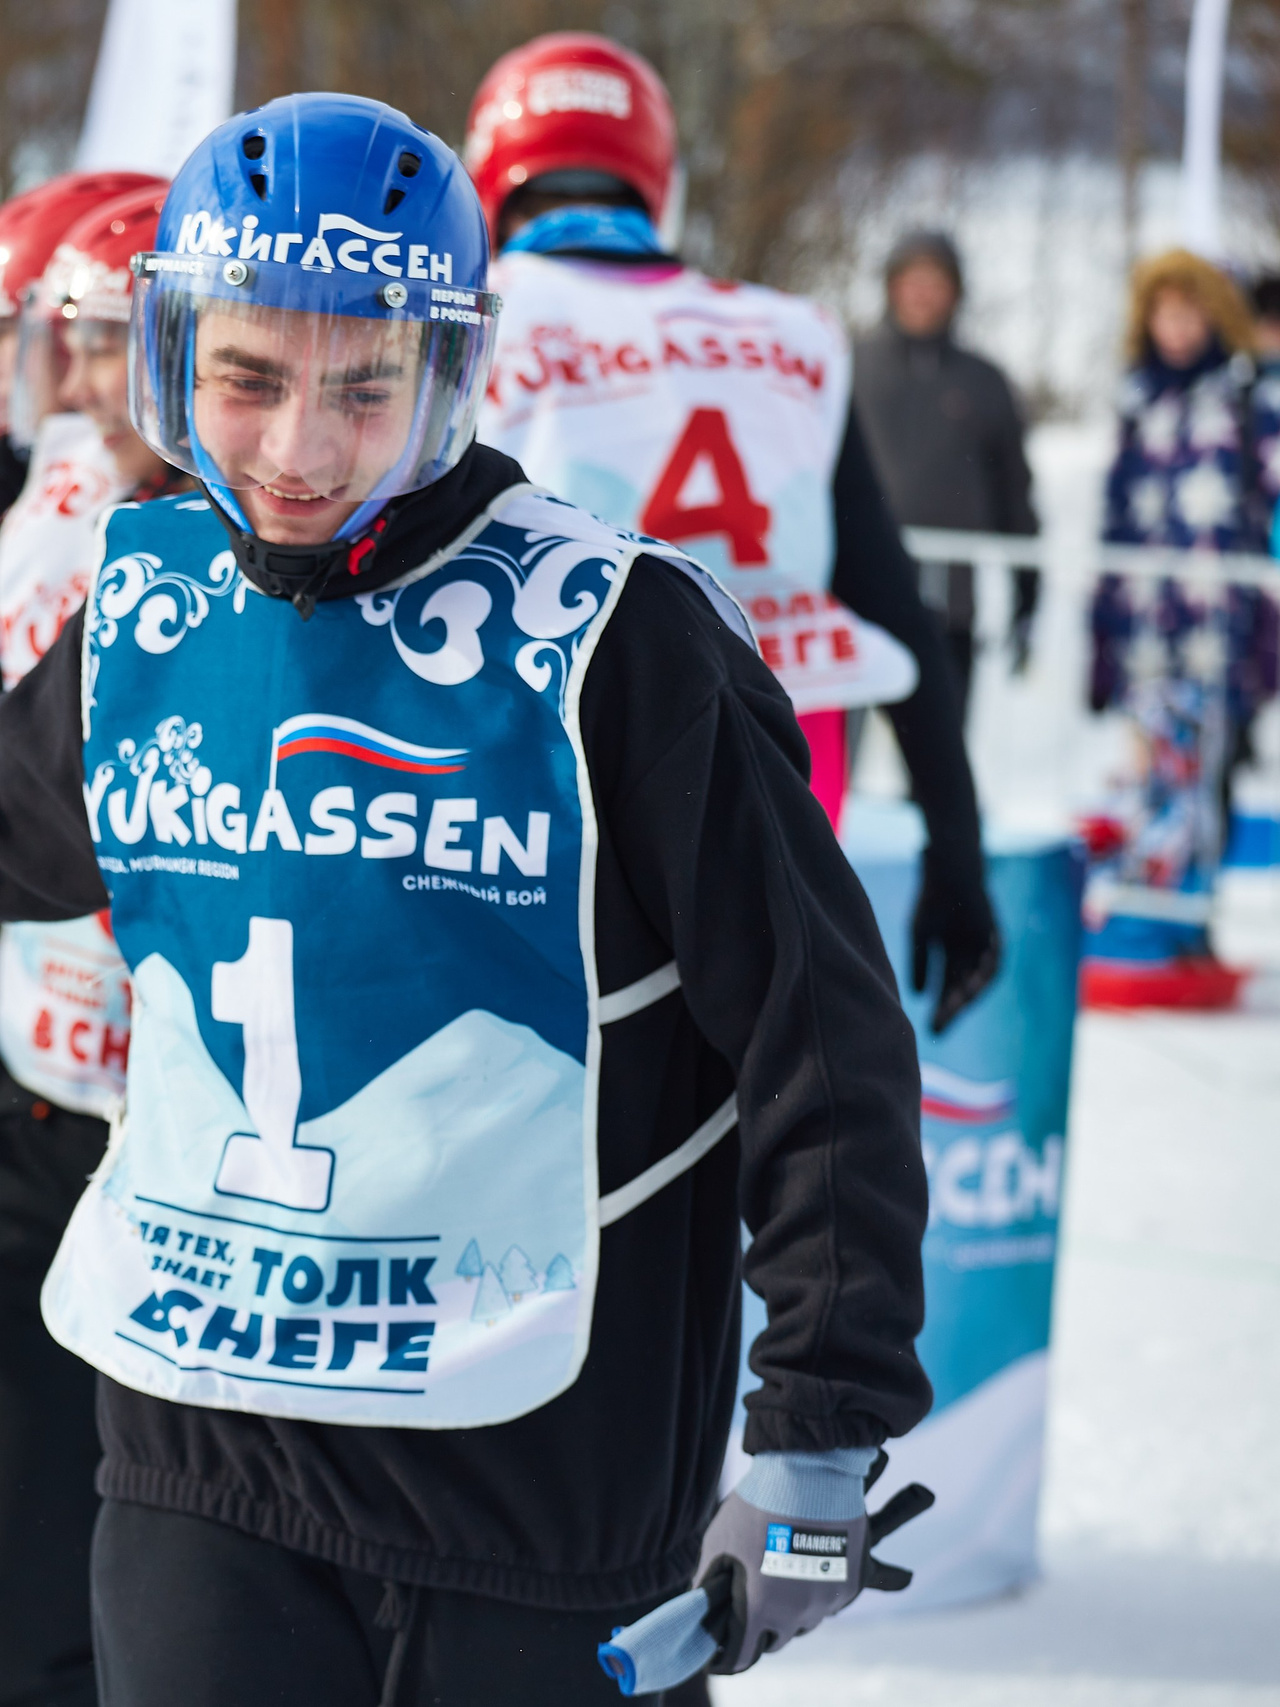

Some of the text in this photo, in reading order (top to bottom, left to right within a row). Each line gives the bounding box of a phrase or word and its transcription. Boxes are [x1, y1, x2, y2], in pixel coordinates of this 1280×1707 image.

[429, 306, 440, 319] В
[430, 288, 476, 307] ПЕРВЫЕ
[639, 407, 772, 568] 4
[402, 874, 547, 907] СНЕЖНЫЙ БОЙ
[210, 915, 336, 1213] 1
[178, 1230, 235, 1266] ТЕХ,
[252, 1246, 438, 1307] ТОЛК
